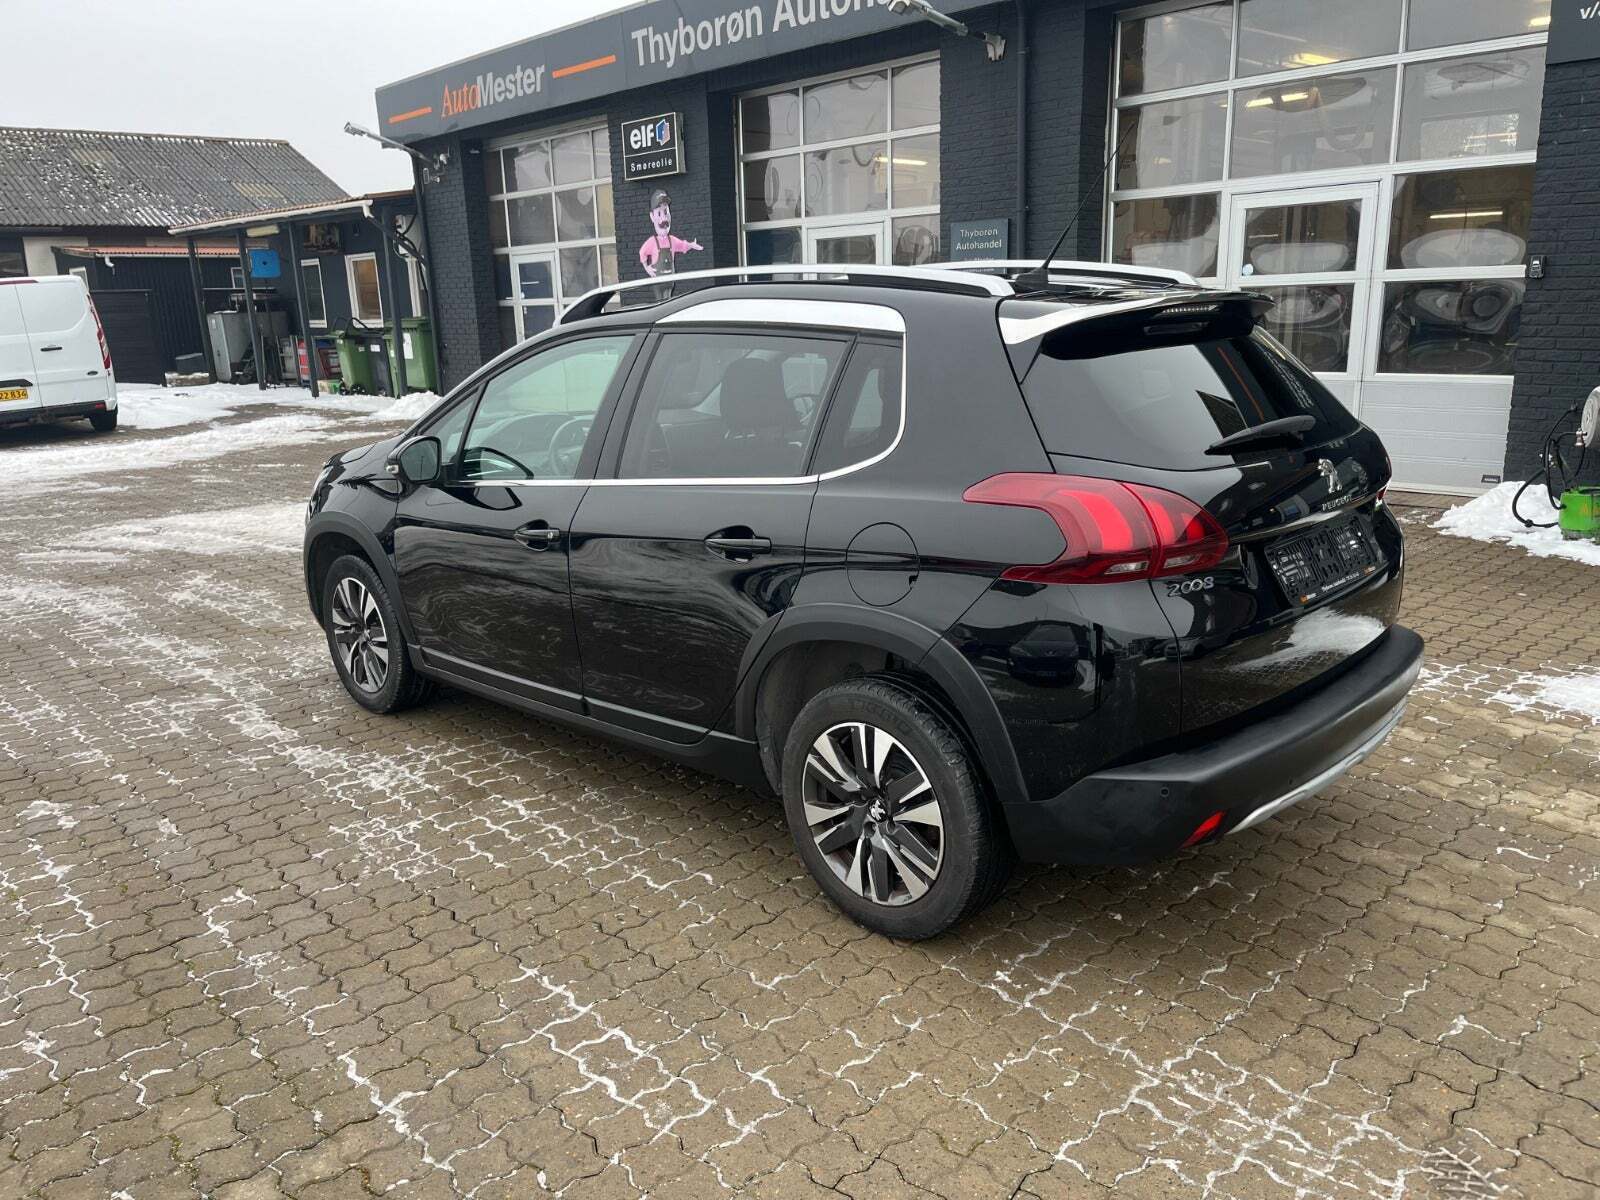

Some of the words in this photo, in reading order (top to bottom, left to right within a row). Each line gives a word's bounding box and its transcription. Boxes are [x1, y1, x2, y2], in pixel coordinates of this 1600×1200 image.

[1579, 1, 1600, 20] v/
[631, 5, 763, 68] Thyborøn
[772, 0, 889, 33] Auto
[441, 64, 545, 118] AutoMester
[630, 123, 655, 150] elf
[955, 239, 1002, 250] Autohandel
[1168, 576, 1215, 598] 2008
